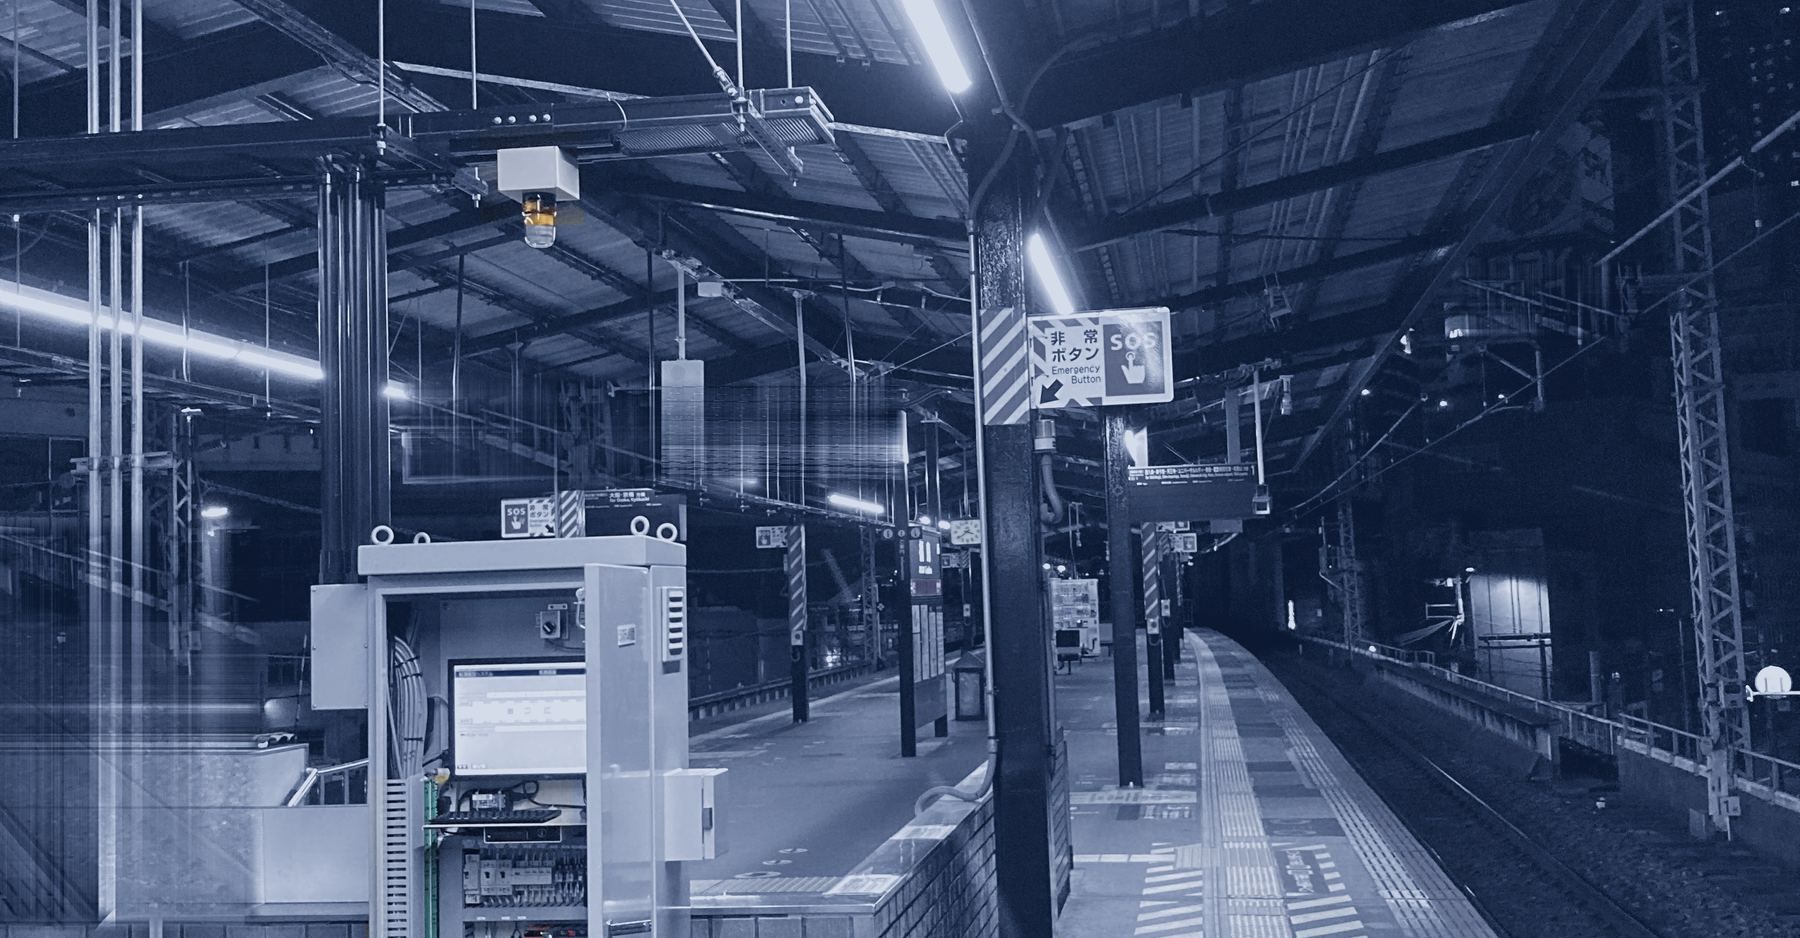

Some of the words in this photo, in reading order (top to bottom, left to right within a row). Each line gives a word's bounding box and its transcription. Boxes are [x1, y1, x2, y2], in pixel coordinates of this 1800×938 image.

[1050, 329, 1098, 346] 非常
[1110, 332, 1156, 351] SOS
[1052, 347, 1099, 362] ボタン
[1051, 365, 1100, 375] Emergency
[1071, 374, 1102, 384] Button
[507, 508, 526, 516] SOS
